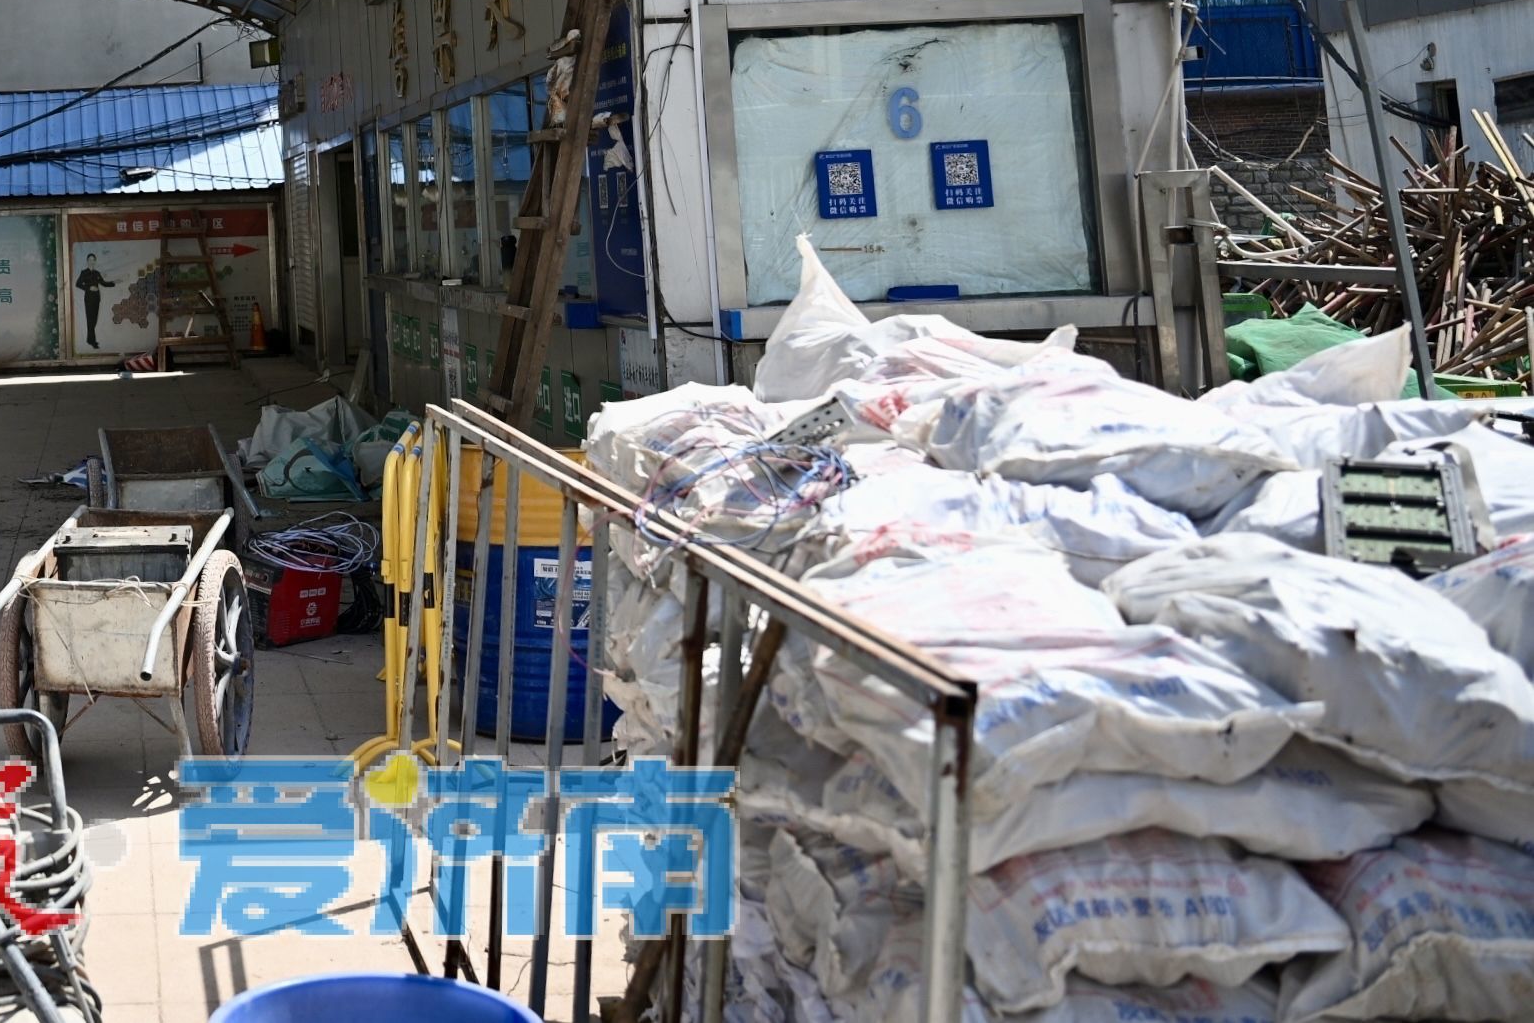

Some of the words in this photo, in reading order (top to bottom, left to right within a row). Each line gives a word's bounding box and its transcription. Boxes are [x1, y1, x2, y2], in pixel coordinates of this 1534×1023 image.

[887, 87, 923, 139] 6
[945, 187, 982, 196] 扫码关注
[828, 197, 866, 206] 扫码关注
[946, 196, 983, 205] 微信购票
[829, 206, 867, 215] 微信购票
